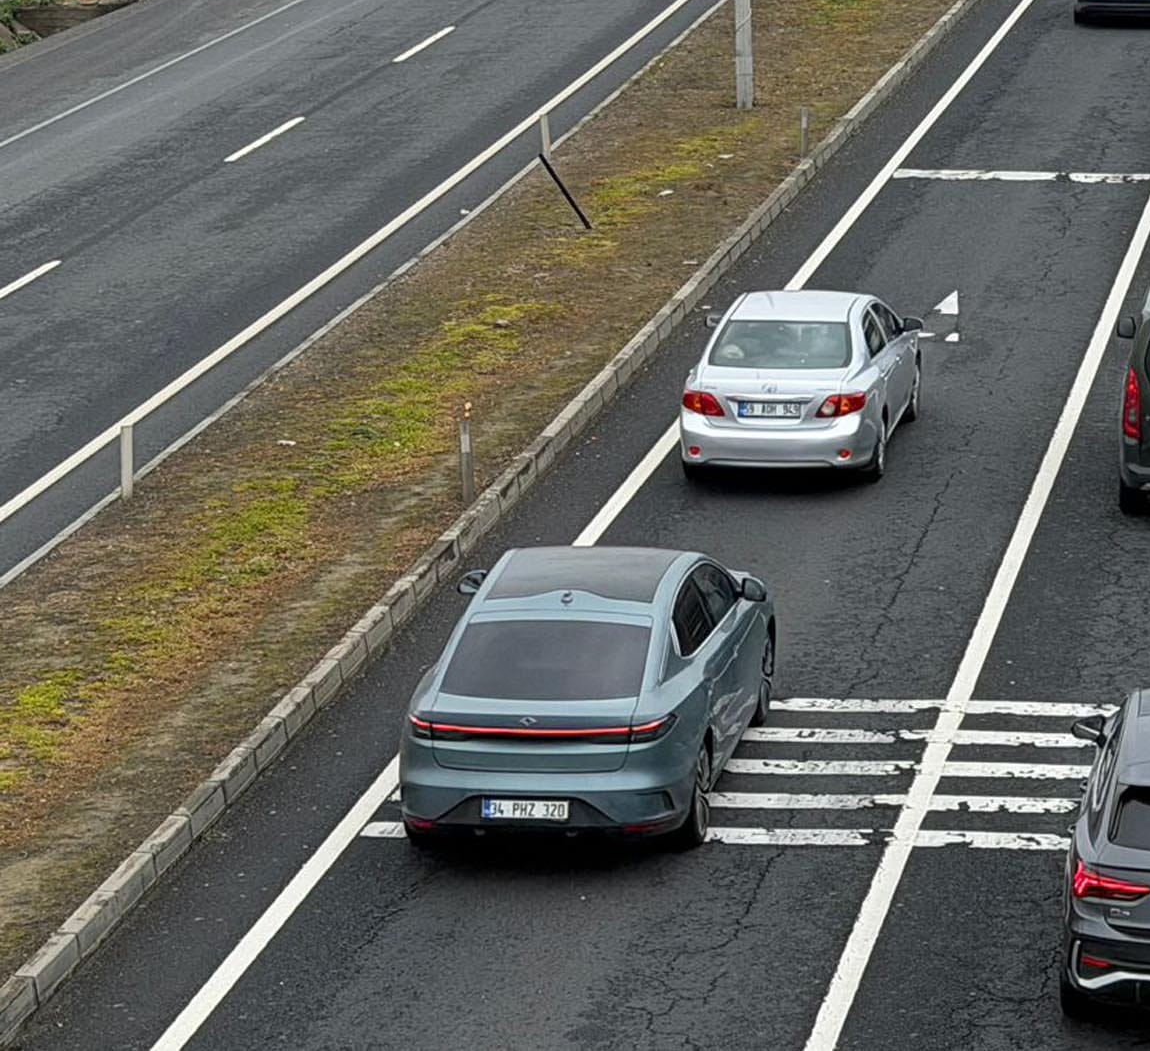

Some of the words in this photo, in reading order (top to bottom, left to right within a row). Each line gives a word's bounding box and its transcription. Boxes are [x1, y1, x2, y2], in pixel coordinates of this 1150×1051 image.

[490, 802, 505, 816] 34
[511, 802, 536, 817] PHZ
[542, 803, 566, 817] 320
